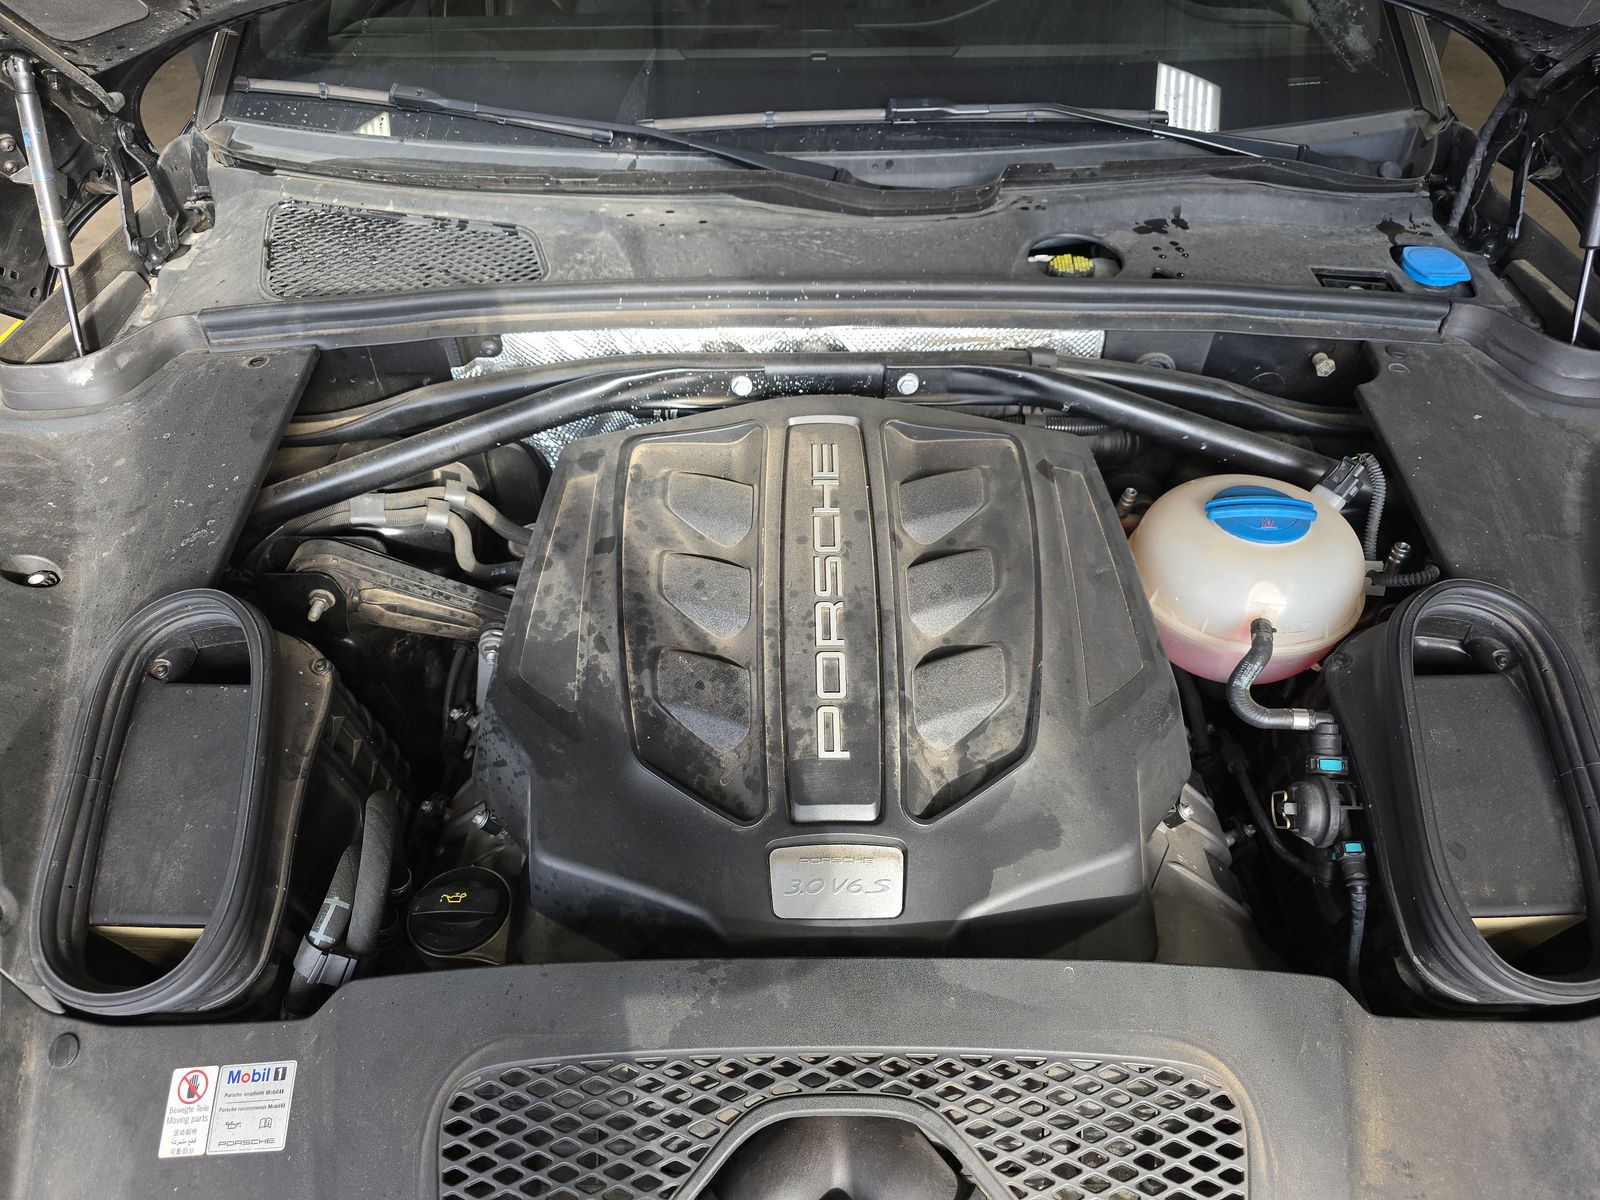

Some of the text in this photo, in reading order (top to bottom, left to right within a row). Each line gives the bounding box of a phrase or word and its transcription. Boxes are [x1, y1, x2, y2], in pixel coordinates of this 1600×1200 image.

[810, 443, 850, 760] PORSCHE
[800, 857, 875, 865] PORSCHE
[784, 878, 892, 897] 3.0 V6 S
[227, 1068, 271, 1084] Mobil
[169, 1104, 210, 1115] Bewegte Teile
[167, 1115, 209, 1125] Moving parts
[218, 1138, 275, 1147] PORSCHE
